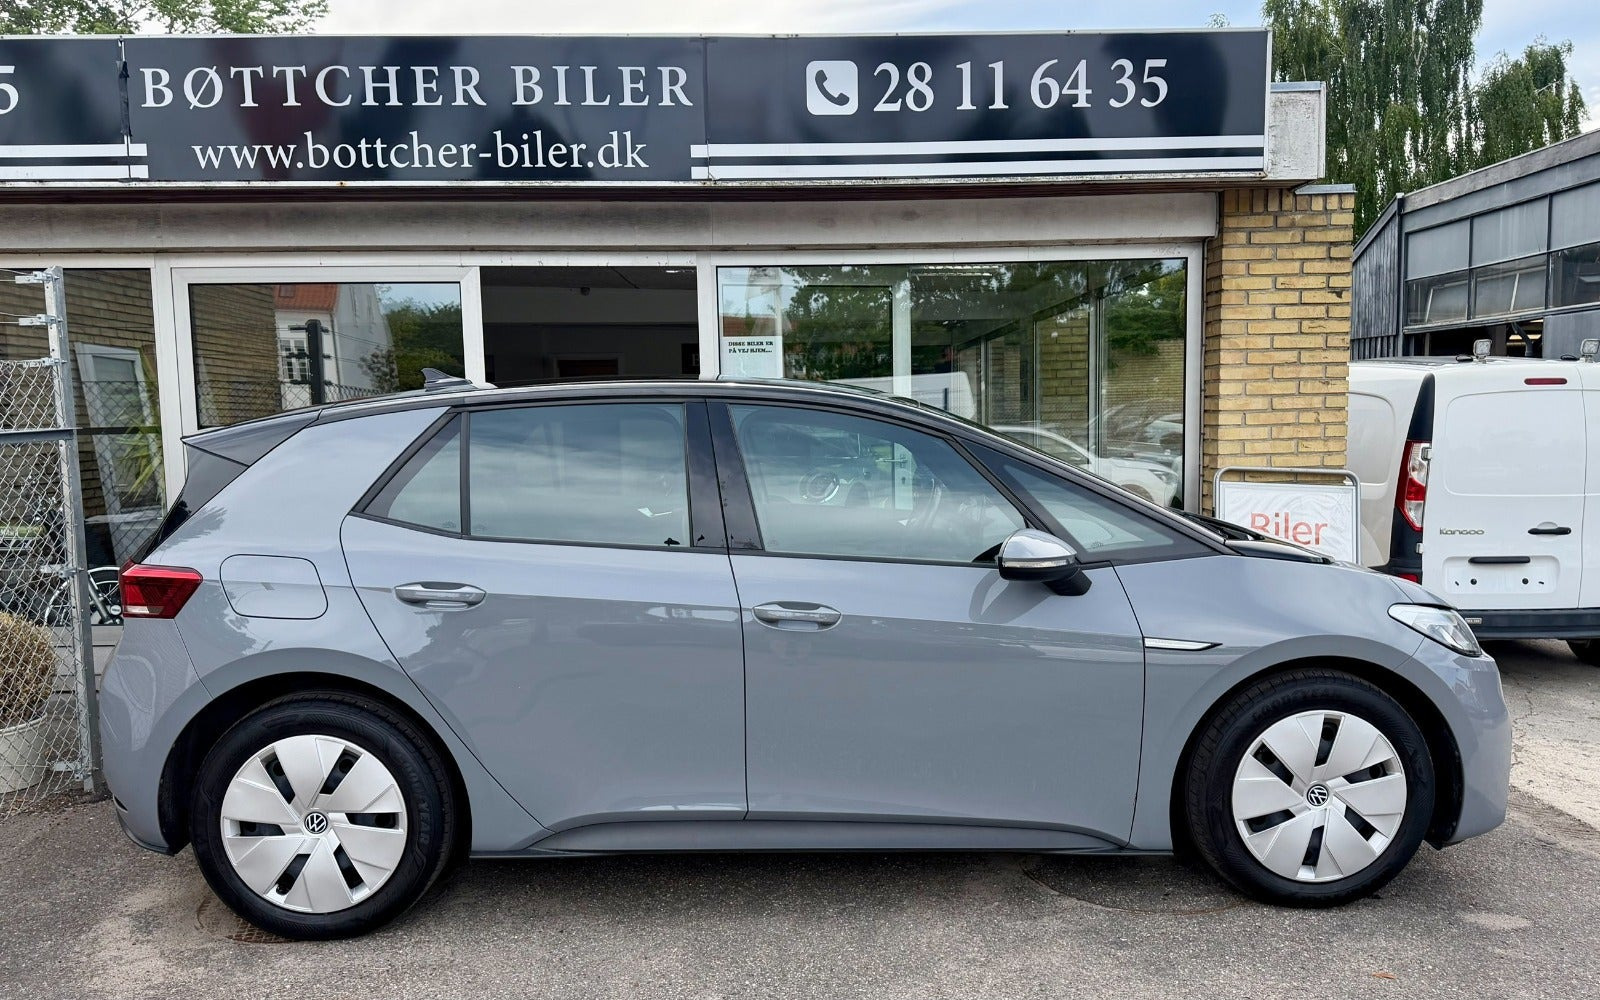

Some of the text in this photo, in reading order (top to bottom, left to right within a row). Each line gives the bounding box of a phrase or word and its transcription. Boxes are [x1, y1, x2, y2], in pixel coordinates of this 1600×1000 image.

[140, 65, 693, 109] BØTTCHER BILER
[873, 58, 1168, 112] 28 11 64 35
[191, 130, 650, 170] www.bottcher-biler.dk
